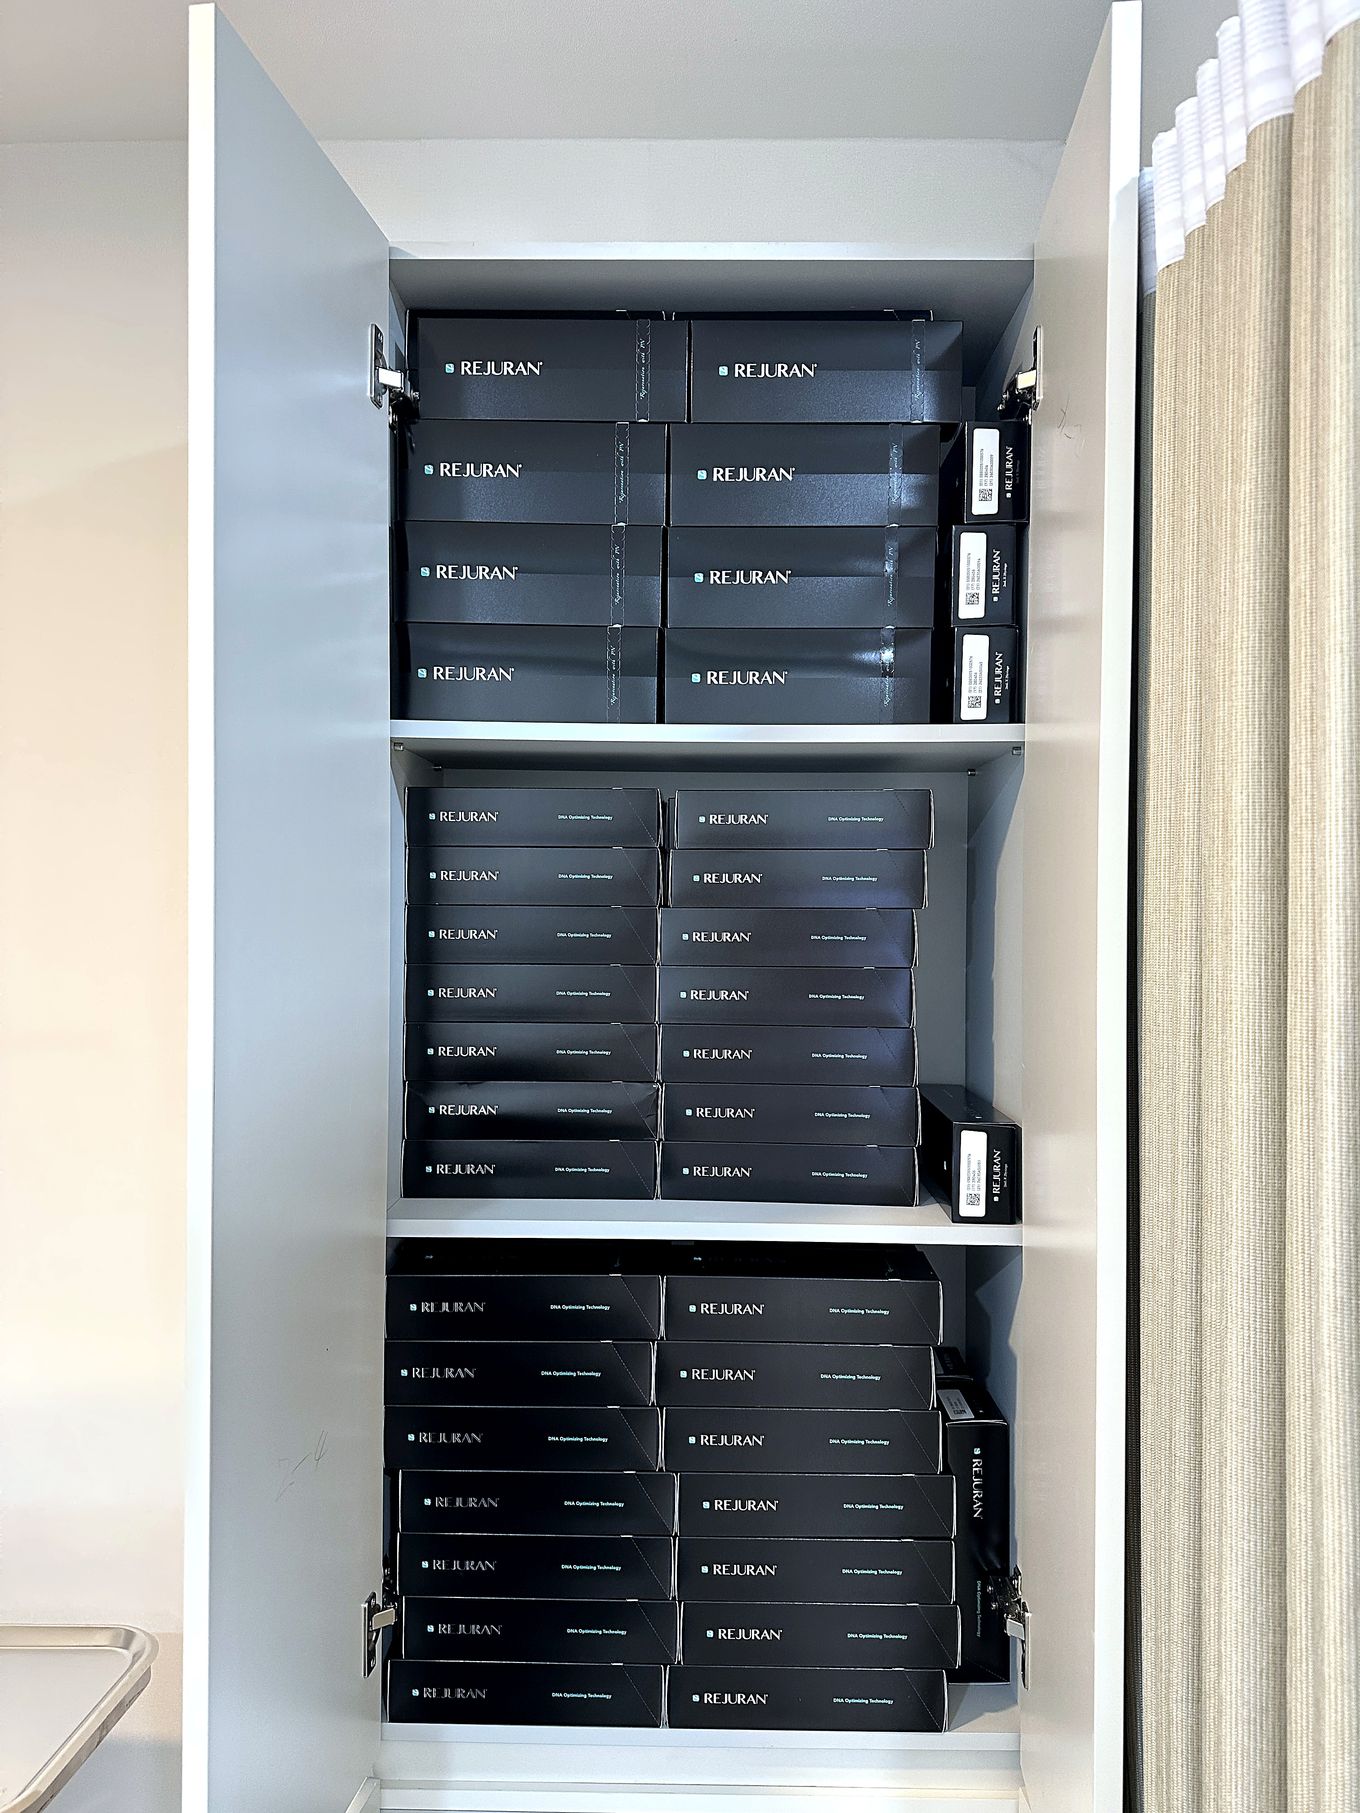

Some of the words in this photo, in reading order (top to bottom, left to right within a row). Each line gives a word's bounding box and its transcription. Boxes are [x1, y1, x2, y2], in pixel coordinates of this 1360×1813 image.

[460, 361, 543, 375] REJURAN
[735, 364, 818, 378] REJURAN
[440, 463, 522, 478] REJURAN
[713, 468, 795, 483] REJURAN
[436, 565, 519, 580] REJURAN
[709, 569, 792, 585] REJURAN
[433, 667, 515, 681] REJURAN
[706, 671, 788, 685] REJURAN
[439, 811, 499, 822] REJURAN
[709, 814, 769, 825] REJURAN
[440, 870, 500, 881] REJURAN
[703, 873, 763, 884] REJURAN
[438, 929, 498, 940] REJURAN
[692, 931, 752, 942] REJURAN
[437, 987, 497, 998] REJURAN
[690, 990, 750, 1001] REJURAN
[437, 1046, 497, 1057] REJURAN
[693, 1049, 753, 1060] REJURAN
[439, 1105, 499, 1116] REJURAN
[695, 1107, 755, 1118] REJURAN
[436, 1164, 496, 1175] REJURAN
[692, 1166, 752, 1177] REJURAN
[700, 1302, 765, 1315] REJURAN
[691, 1368, 756, 1381] REJURAN
[700, 1433, 765, 1446] REJURAN
[972, 1458, 983, 1519] REJURAN
[714, 1498, 779, 1511] REJURAN
[713, 1563, 778, 1576] REJURAN
[718, 1627, 783, 1640] REJURAN
[704, 1692, 769, 1705] REJURAN
